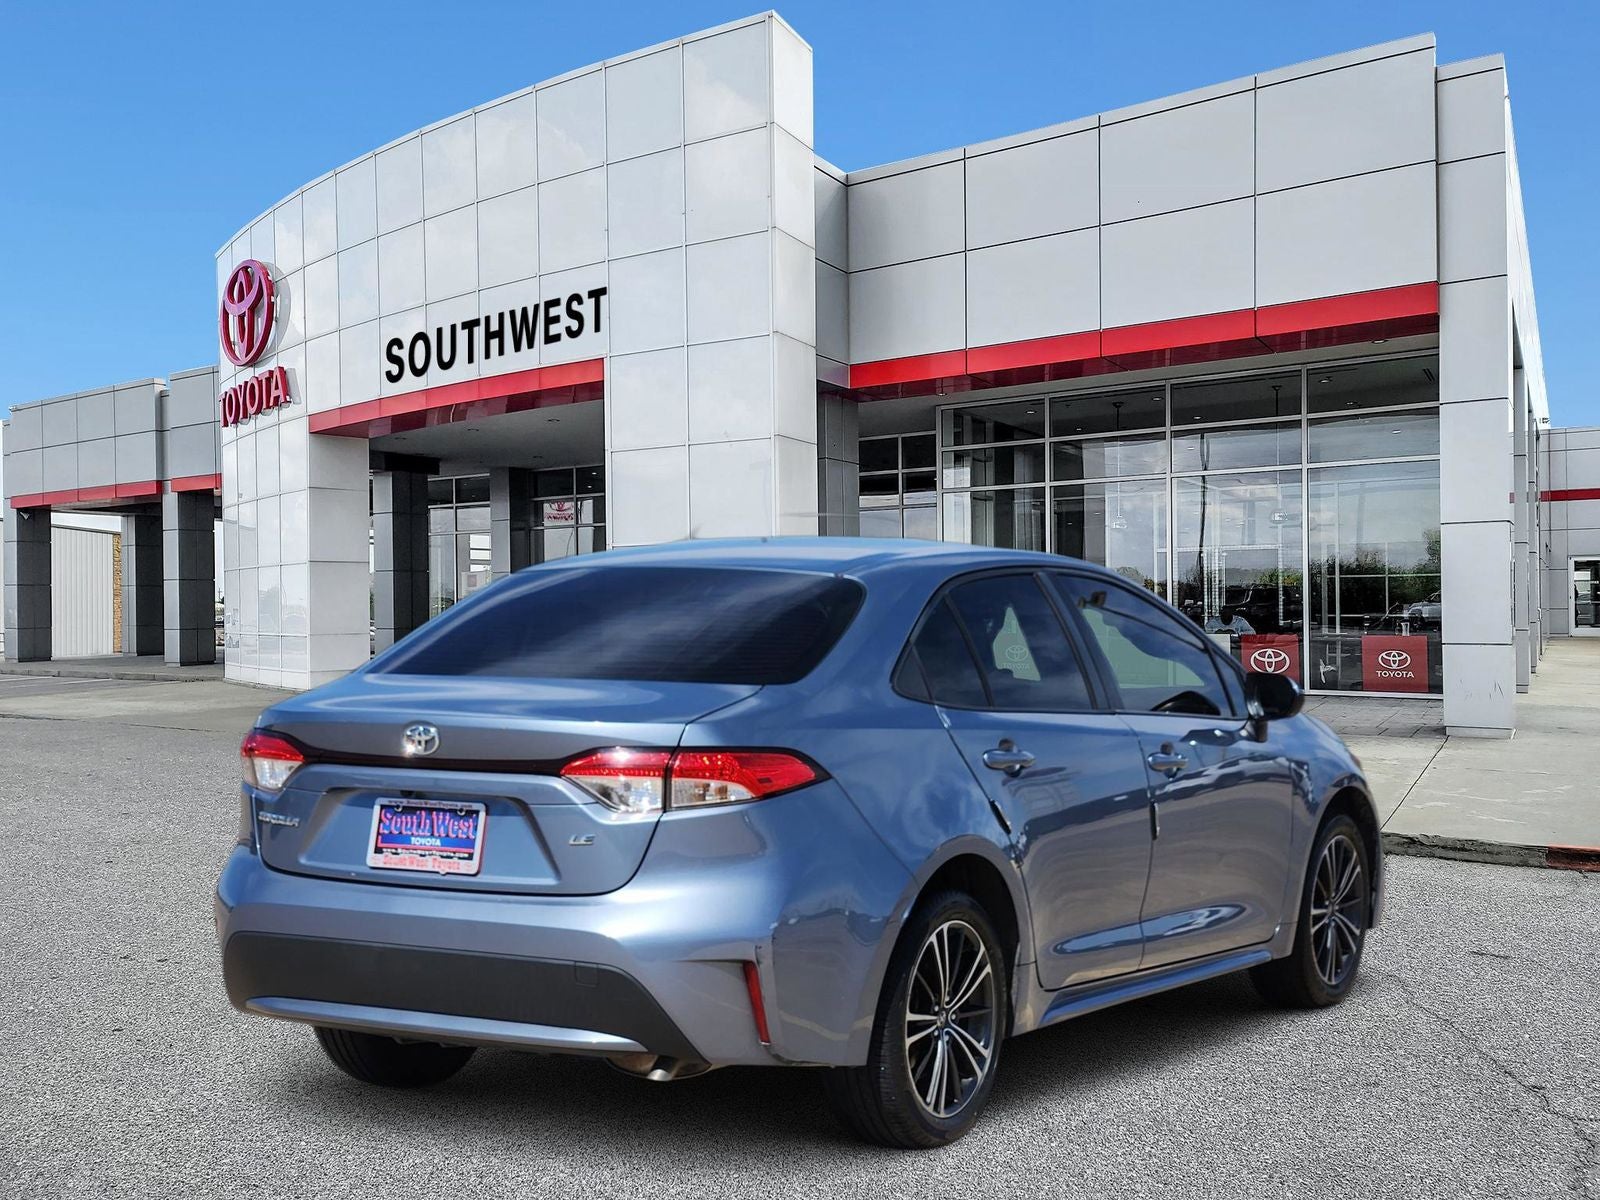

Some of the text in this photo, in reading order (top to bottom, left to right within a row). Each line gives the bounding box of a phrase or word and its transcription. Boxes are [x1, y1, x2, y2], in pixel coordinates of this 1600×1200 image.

[385, 286, 608, 384] SOUTHWEST
[219, 366, 290, 428] TOYOTA
[1376, 670, 1415, 678] TOYOTA
[410, 837, 441, 846] TOYOTA
[569, 833, 597, 846] LE
